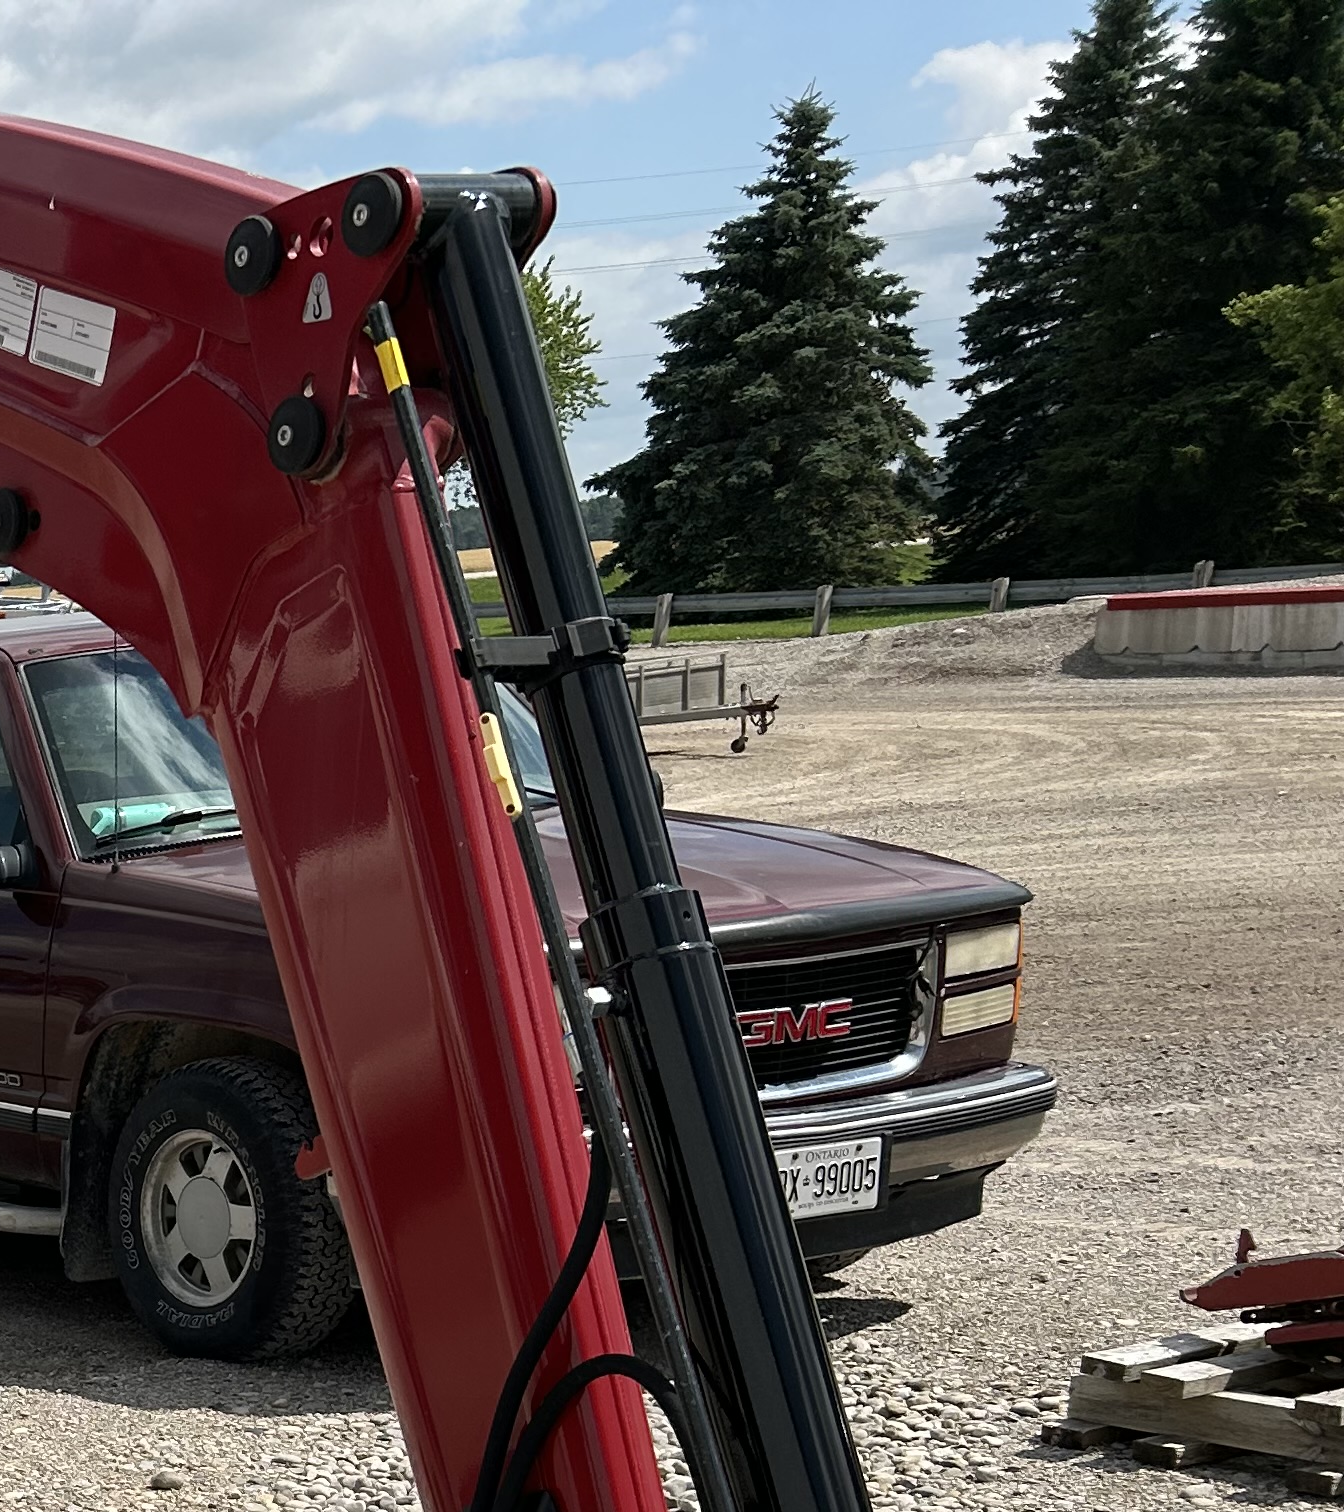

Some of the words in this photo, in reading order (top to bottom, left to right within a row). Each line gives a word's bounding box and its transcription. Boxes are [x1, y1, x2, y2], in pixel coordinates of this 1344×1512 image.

[736, 997, 853, 1048] GMC
[805, 1147, 850, 1163] ONTARIO
[119, 1109, 177, 1269] GOODYEAR
[813, 1156, 878, 1198] 99005
[156, 1299, 235, 1329] RADIAL
